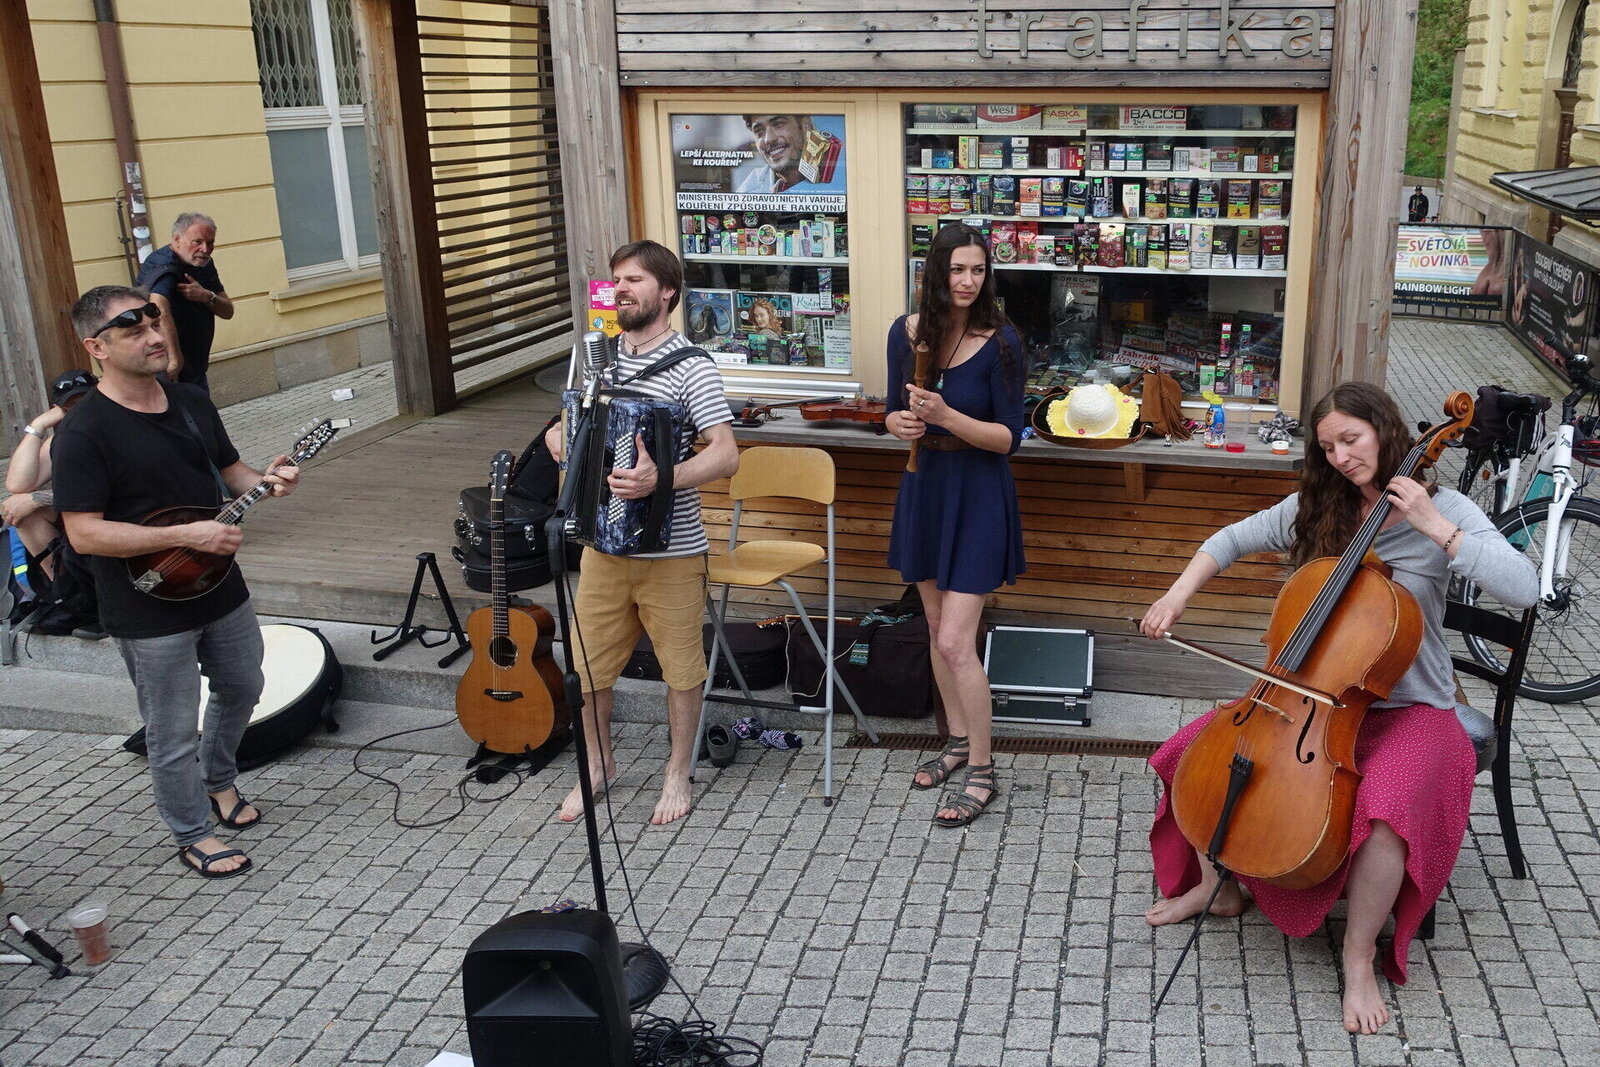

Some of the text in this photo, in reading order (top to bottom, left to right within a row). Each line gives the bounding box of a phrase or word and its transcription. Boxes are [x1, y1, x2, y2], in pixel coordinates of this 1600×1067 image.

[973, 0, 1322, 61] trafika
[990, 104, 1014, 115] West
[680, 149, 753, 159] LEPŠÍ ALTERNATIVA
[678, 194, 845, 204] MINISTERSTVO ZDRAVOTNICTVÍ VARUJE:
[679, 202, 844, 212] KOUŘENÍ ZPŮSOBUJE RAKOVINU
[1409, 236, 1466, 252] SVĚTOVÁ
[1410, 254, 1469, 268] NOVINKA
[1394, 282, 1471, 296] RAINBOW LIGHT
